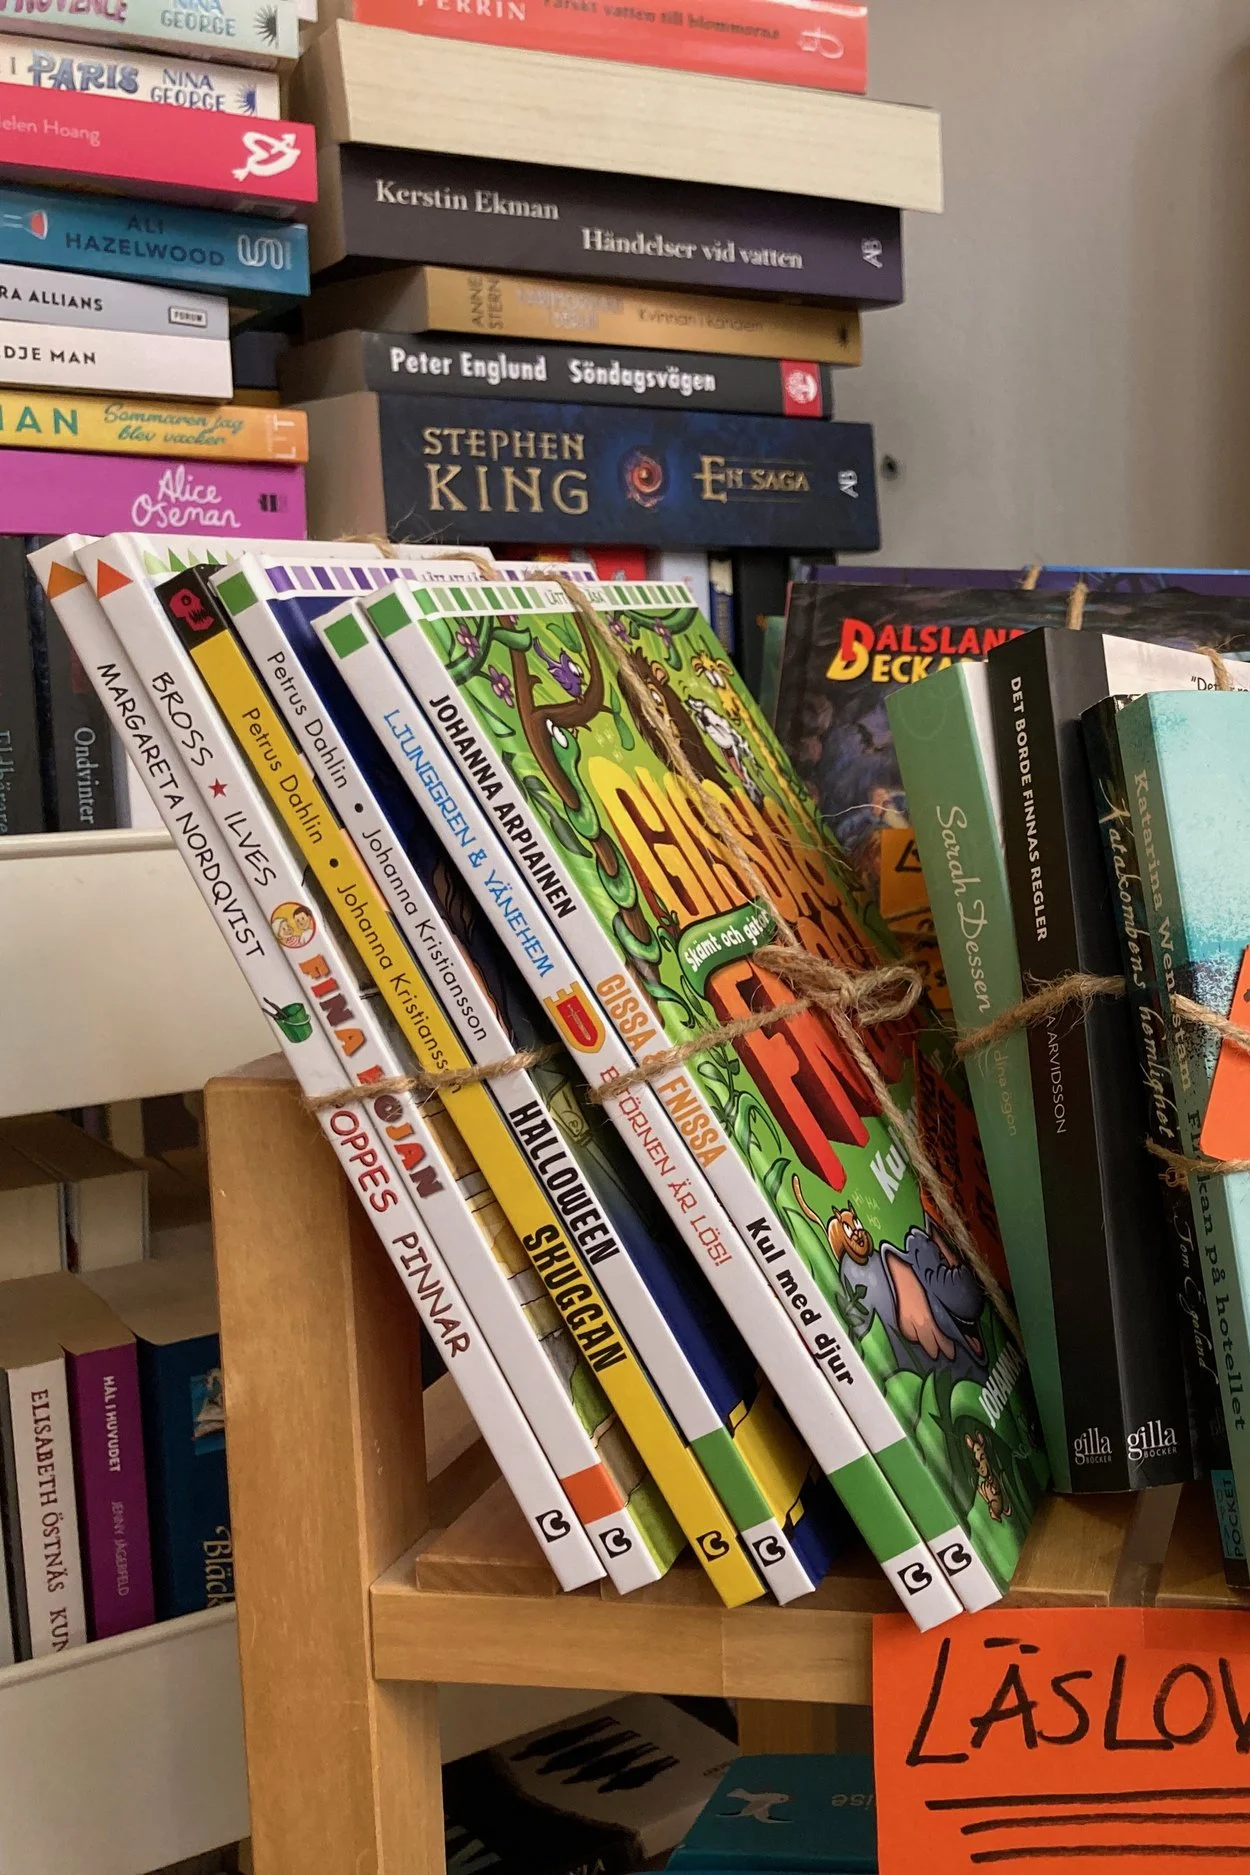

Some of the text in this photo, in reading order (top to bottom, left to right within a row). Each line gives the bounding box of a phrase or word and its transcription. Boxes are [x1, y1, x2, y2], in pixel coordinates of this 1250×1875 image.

[161, 11, 237, 37] GEORGE
[660, 11, 683, 26] till
[28, 50, 140, 94] PARIS
[163, 68, 214, 91] NINA
[151, 87, 226, 113] GEORGE
[0, 116, 101, 148] elen Hoang
[127, 215, 165, 234] ALI
[376, 178, 561, 221] Kerstin Ekman
[65, 232, 226, 267] HAZELWOOD
[582, 227, 804, 271] Händelser vid vatten
[29, 289, 104, 312] ALLIANS
[173, 311, 204, 324] FORUM
[50, 350, 97, 365] MAN
[390, 347, 717, 395] Peter Englund Söndagsvägen
[0, 406, 79, 436] AN
[104, 402, 245, 434] Sommaren jag
[118, 425, 228, 446] blev vacker
[422, 426, 586, 461] STEPHEN
[131, 493, 242, 528] Oseman
[157, 464, 222, 504] Alice
[425, 461, 590, 516] KING
[73, 726, 101, 825] Ondvinter
[151, 671, 277, 888] BROSS ILVES
[383, 708, 477, 849] LJUNGGREN
[466, 847, 489, 869] &
[97, 662, 266, 958] MARGARETA NORDQVIST
[429, 694, 579, 920] JOHANNA ARPIAINEN
[1009, 676, 1048, 943] DET BORDE FINNAS REGLER
[267, 650, 489, 1043] Petrus Dahlin Johanna Kristiansson
[241, 706, 463, 1095] Petrus Dahlin Johanna Kristianssn
[935, 804, 992, 1015] Sarah Dessen
[1097, 776, 1149, 990] Katakombens
[720, 924, 747, 948] och
[1133, 768, 1192, 1092] Katarina Wenstam
[298, 953, 369, 1058] FINA
[596, 972, 658, 1053] GISSA
[656, 1075, 732, 1170] FNISSA
[1046, 1031, 1068, 1135] ARVIDSSON
[508, 1100, 622, 1267] HALLOWEEN
[329, 1092, 472, 1359] OPPES PINNAR
[668, 1179, 700, 1216] ÄR
[690, 1216, 735, 1268] LÖS!
[1172, 1214, 1195, 1269] Tom
[522, 1222, 629, 1375] SKUGGAN
[745, 1215, 855, 1388] Kul med djur
[1204, 1243, 1247, 1431] på hotellet
[30, 1387, 59, 1506] ELISABETH
[105, 1412, 122, 1474] HUVUDET
[1073, 1426, 1113, 1466] gilla
[1126, 1419, 1179, 1462] gilla
[1221, 1477, 1248, 1558] POCKET
[40, 1510, 66, 1595] ÖSTNÄS
